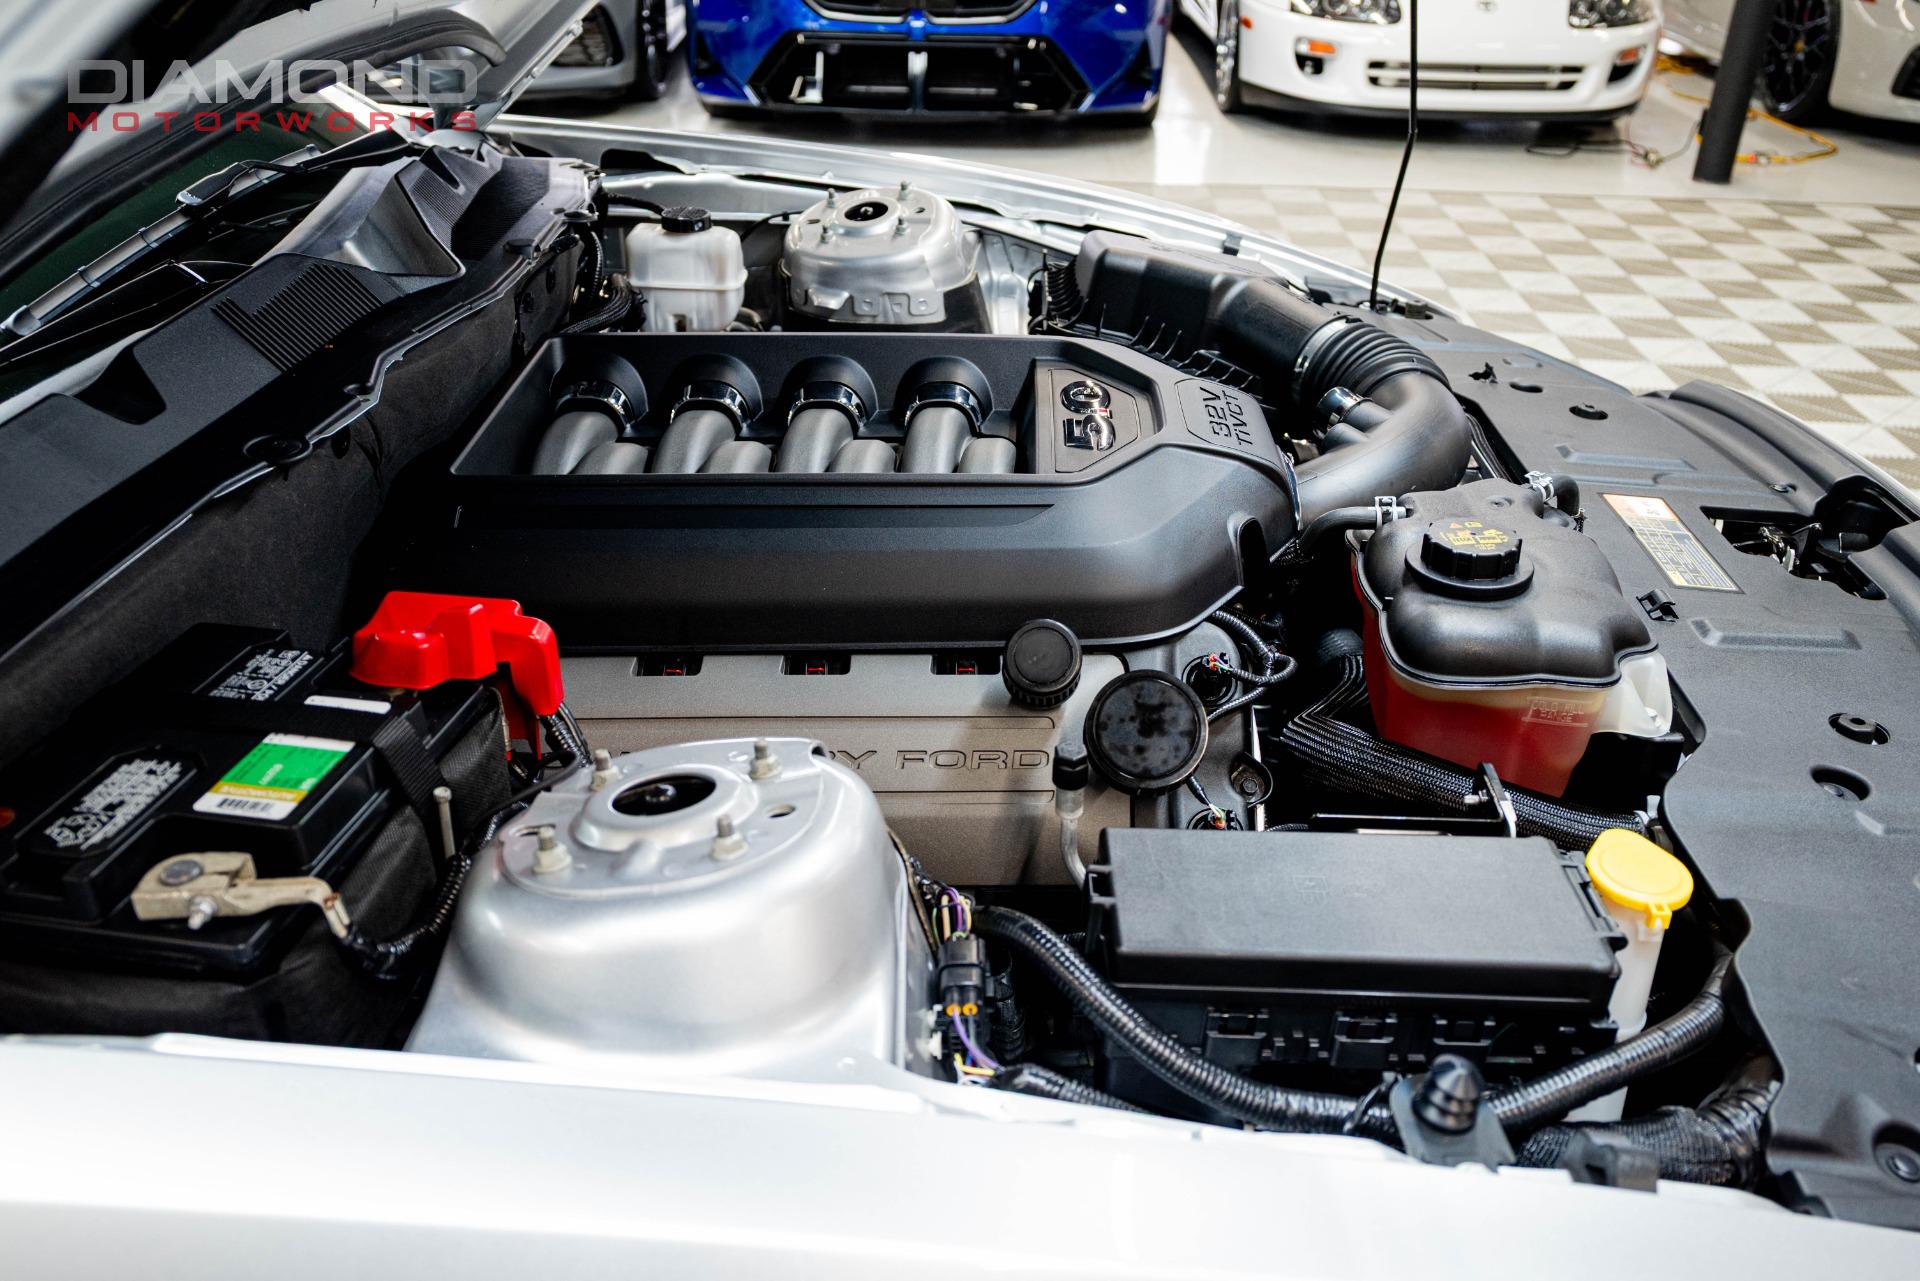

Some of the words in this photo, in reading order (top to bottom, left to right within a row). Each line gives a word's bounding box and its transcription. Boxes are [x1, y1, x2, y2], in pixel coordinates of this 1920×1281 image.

[1199, 386, 1232, 438] 32V
[828, 750, 877, 770] Y
[895, 749, 1050, 770] FORD
